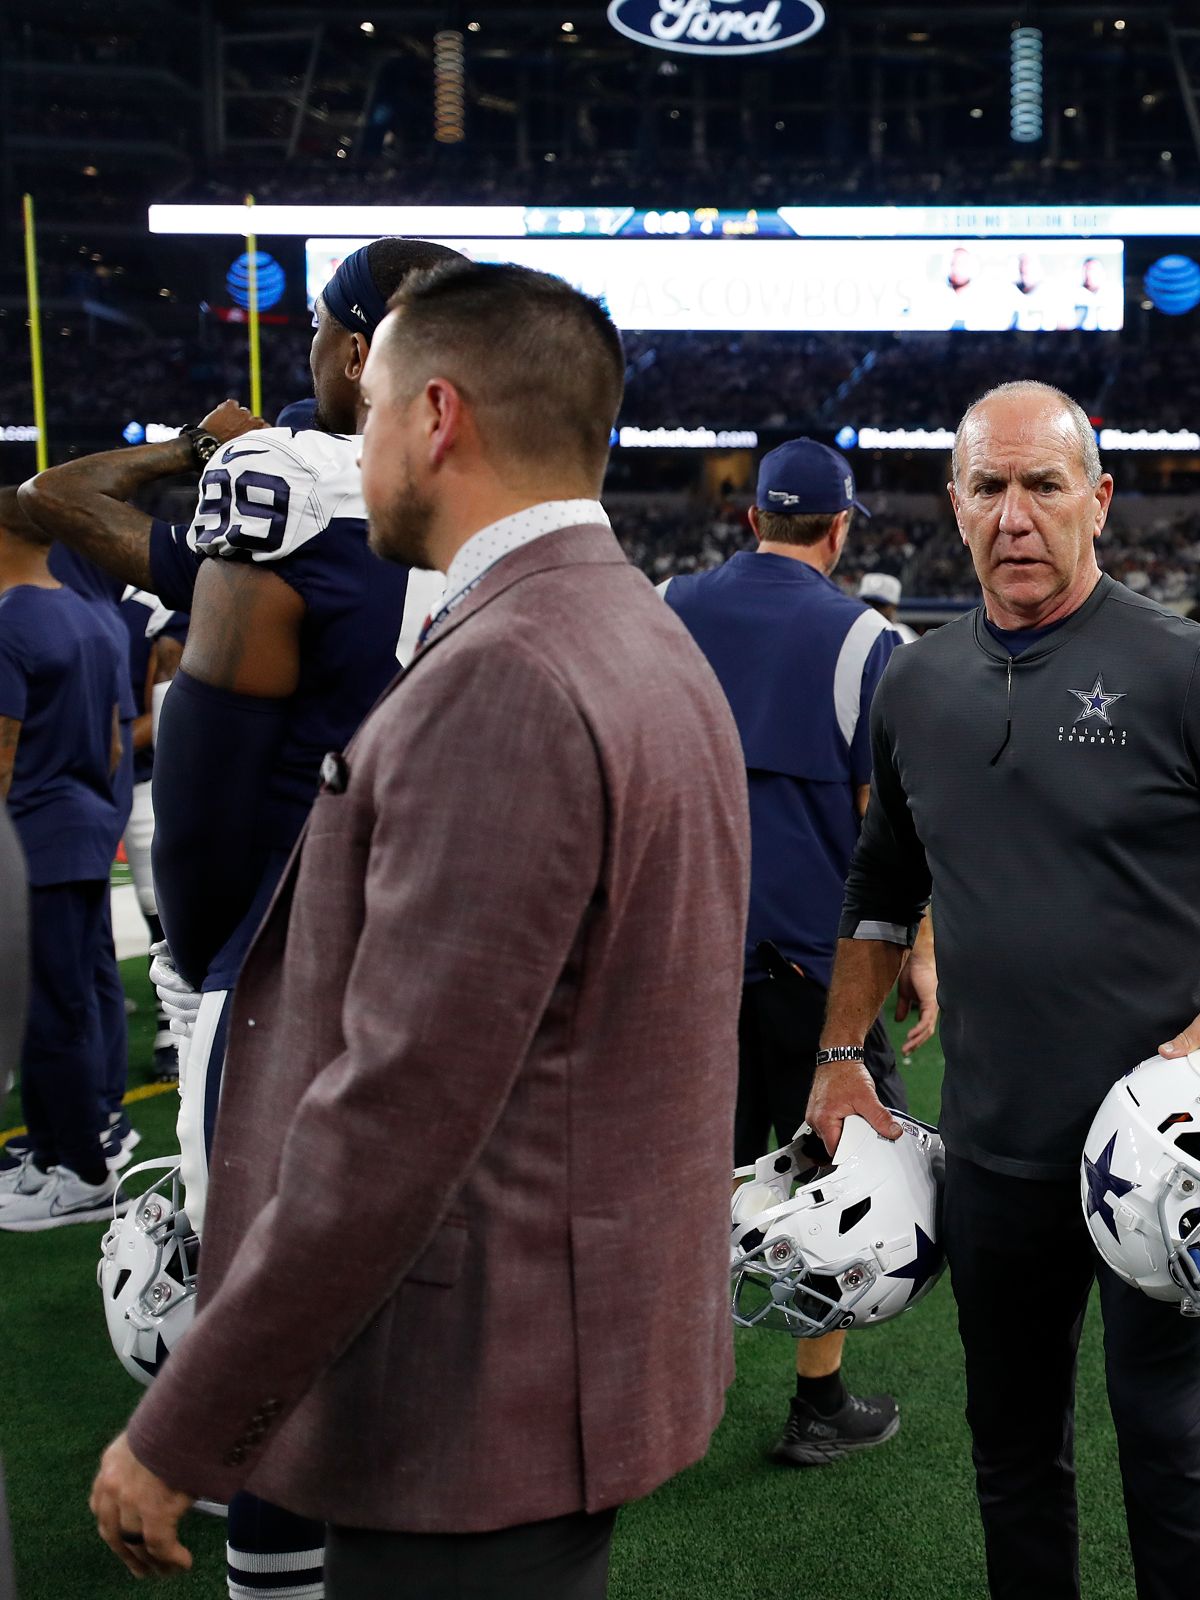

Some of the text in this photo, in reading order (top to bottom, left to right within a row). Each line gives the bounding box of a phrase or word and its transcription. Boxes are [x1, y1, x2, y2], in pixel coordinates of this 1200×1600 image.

[650, 0, 782, 42] Ford
[195, 468, 291, 553] 99
[1058, 726, 1127, 738] DALLAS
[1058, 734, 1127, 746] COWBOYS
